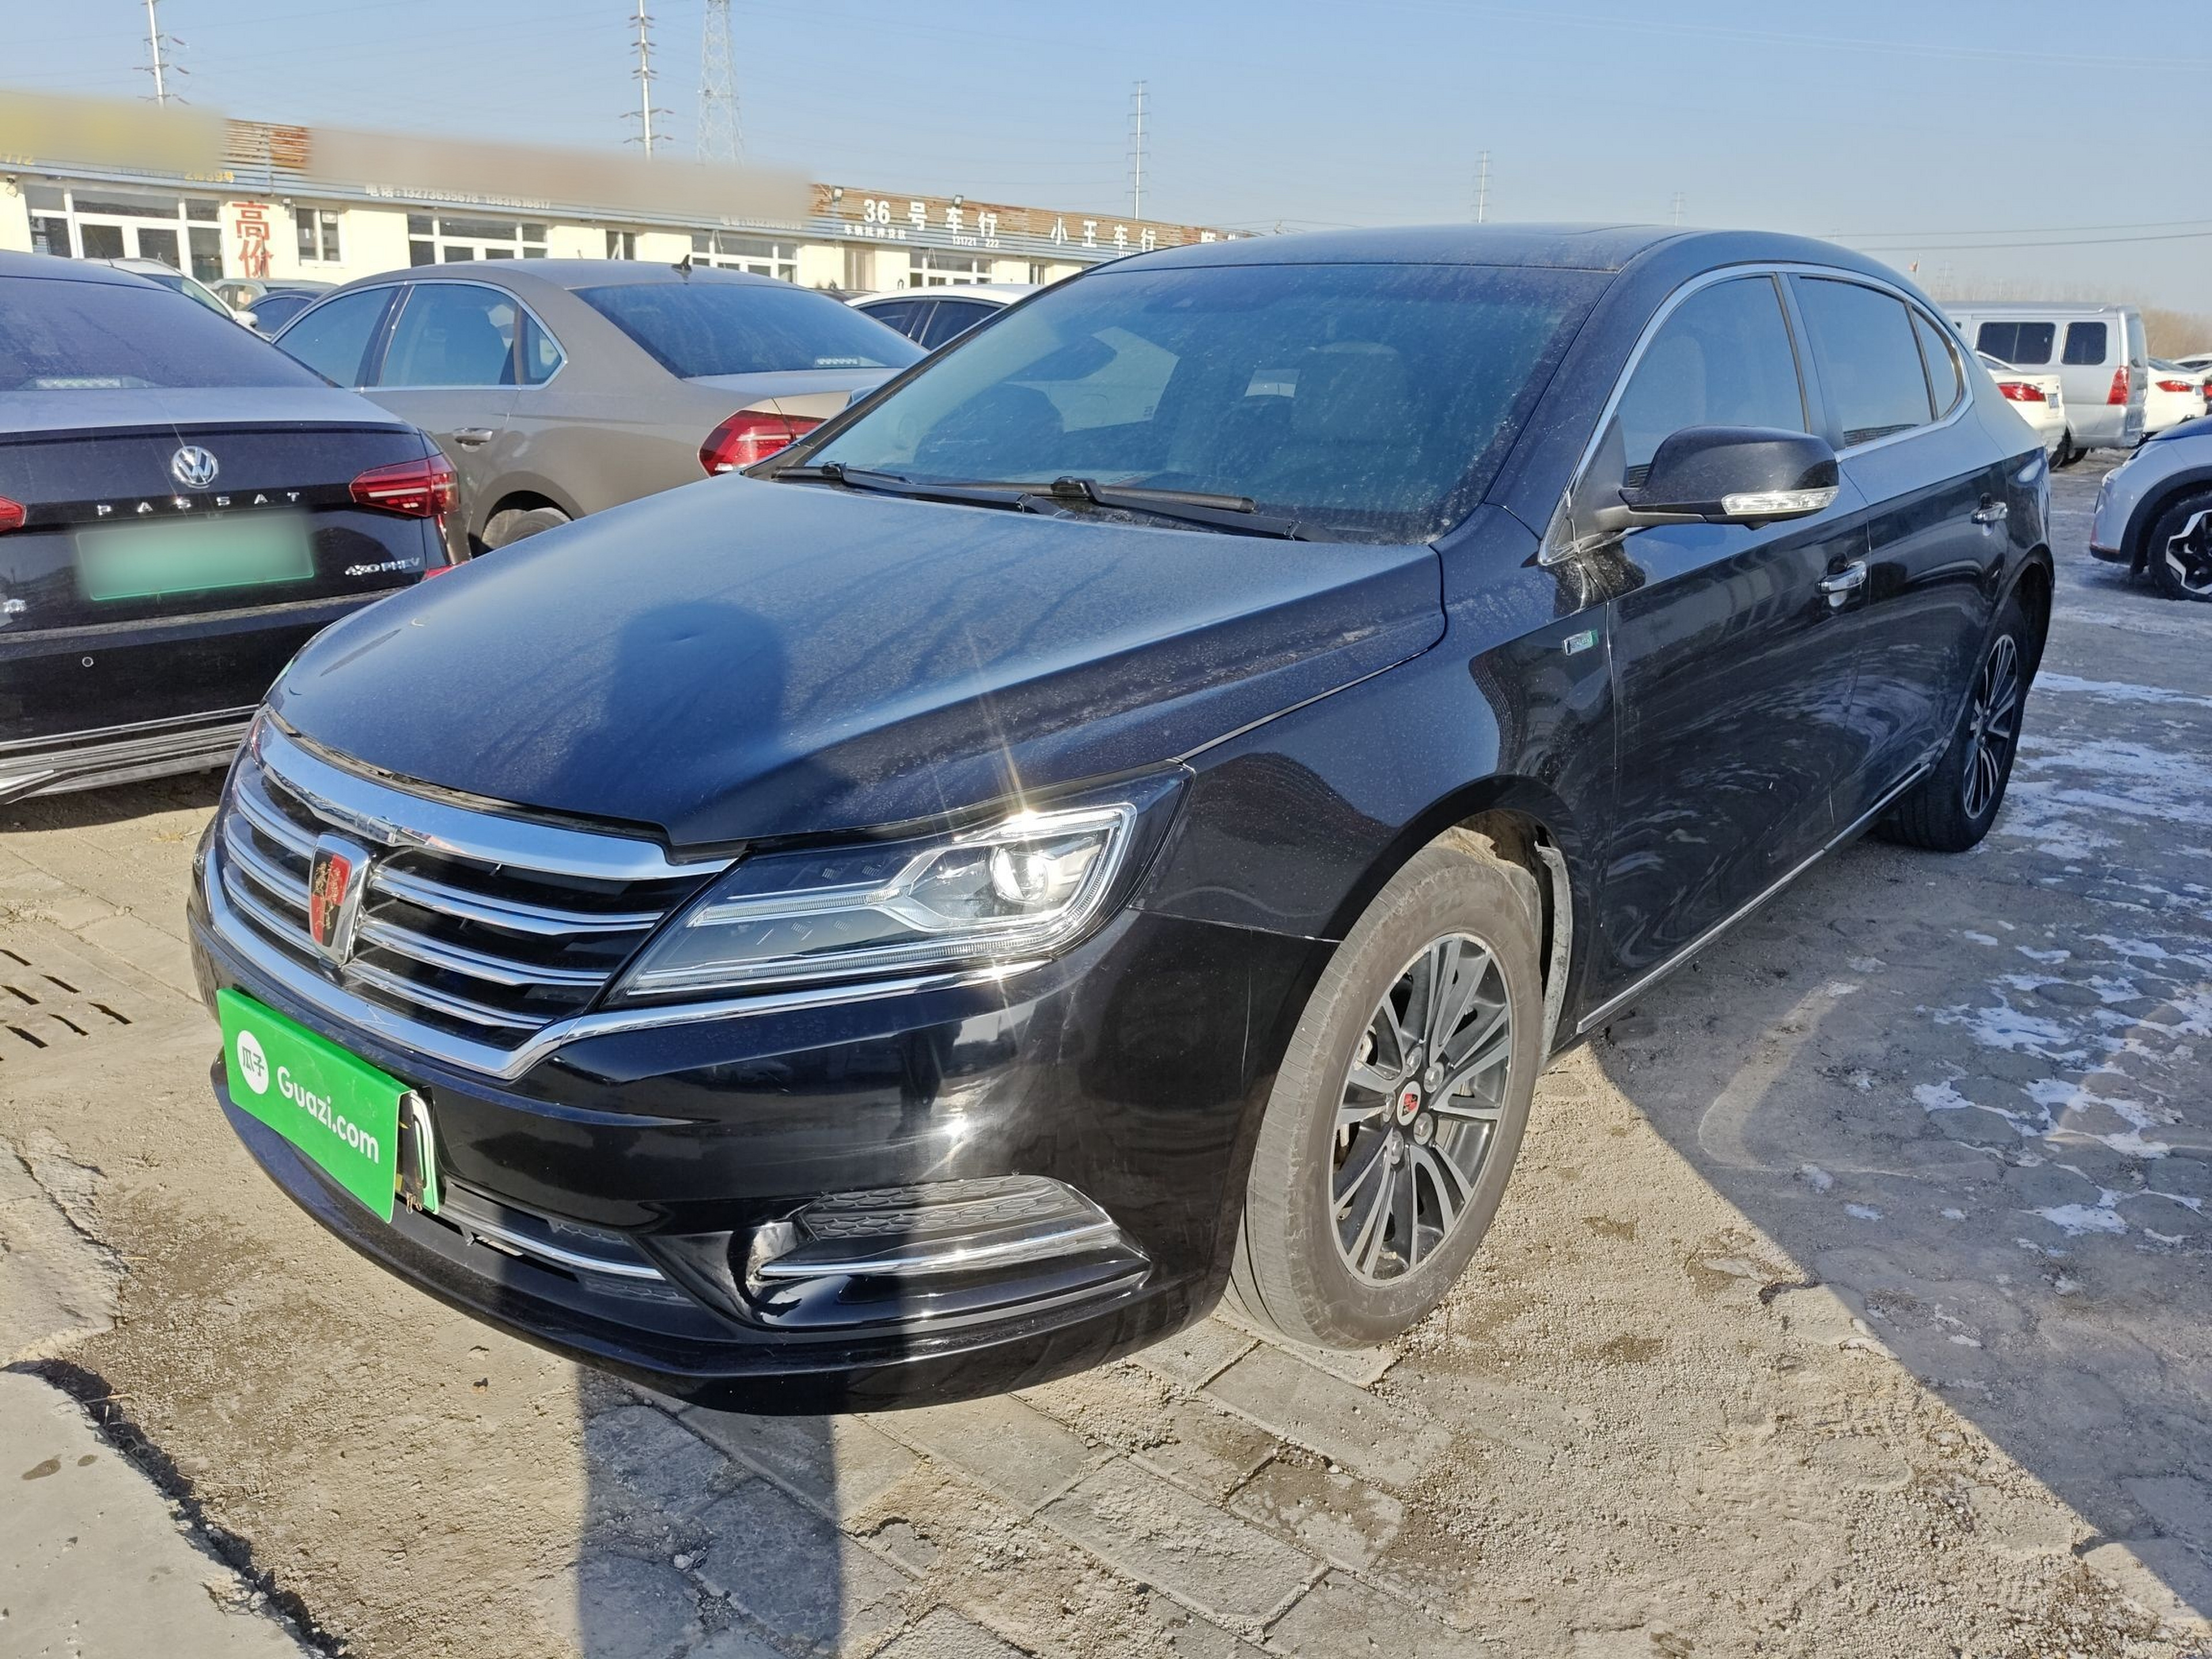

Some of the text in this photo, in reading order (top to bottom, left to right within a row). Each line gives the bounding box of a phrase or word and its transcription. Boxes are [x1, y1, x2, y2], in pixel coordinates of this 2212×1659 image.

[863, 199, 998, 238] 36号车行
[1050, 217, 1156, 252] 小王车行
[97, 492, 300, 516] PASSAT
[242, 1046, 264, 1077] 瓜子
[277, 1066, 379, 1164] Guazi.com
